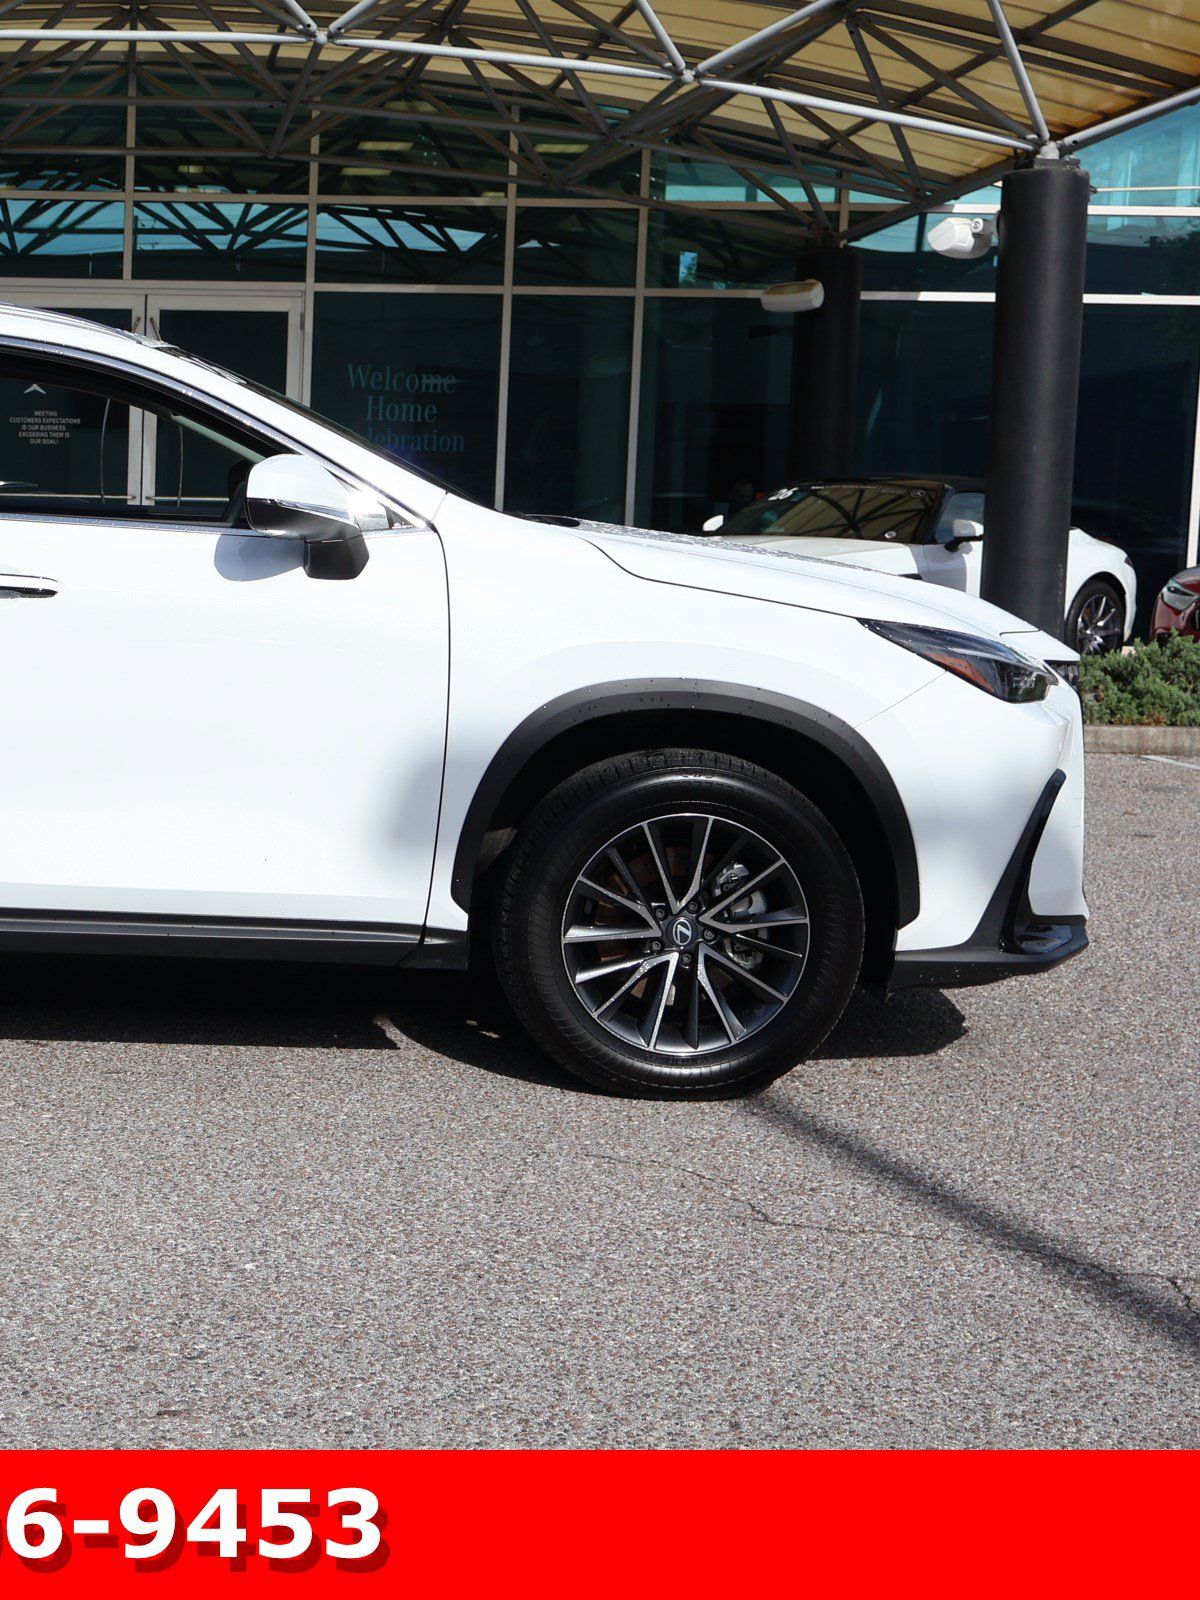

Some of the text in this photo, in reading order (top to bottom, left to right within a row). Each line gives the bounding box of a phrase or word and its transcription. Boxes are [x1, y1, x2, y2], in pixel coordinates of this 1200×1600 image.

[346, 363, 456, 394] Welcome
[366, 395, 437, 422] Home
[367, 426, 465, 452] lebration
